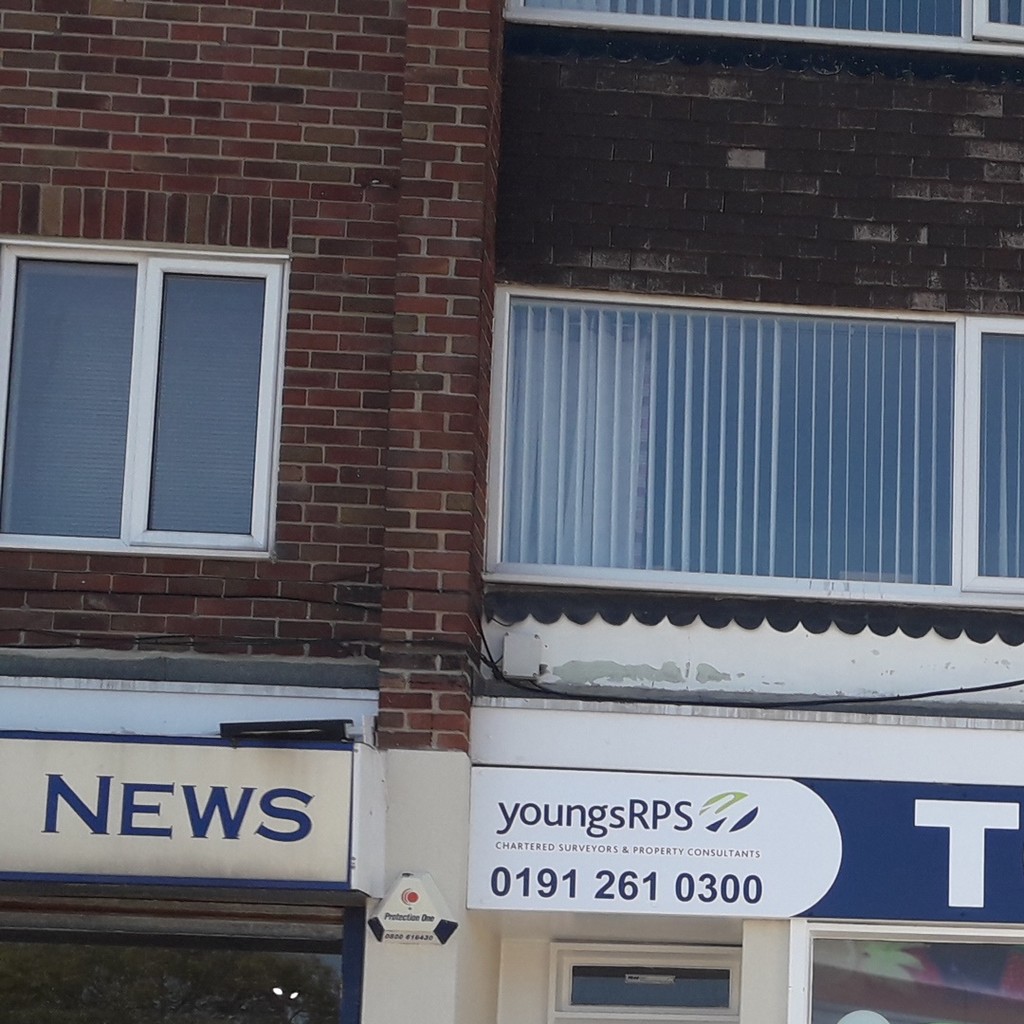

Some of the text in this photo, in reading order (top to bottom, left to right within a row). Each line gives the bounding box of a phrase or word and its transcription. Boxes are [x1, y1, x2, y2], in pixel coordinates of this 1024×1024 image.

[41, 773, 315, 842] NEWS
[496, 799, 693, 837] youngsRPS
[495, 841, 761, 858] CHARTERED SURVEYORS & PROPERTY CONSULTANTS
[491, 866, 763, 904] 0191 261 0300
[384, 912, 435, 922] Protection One
